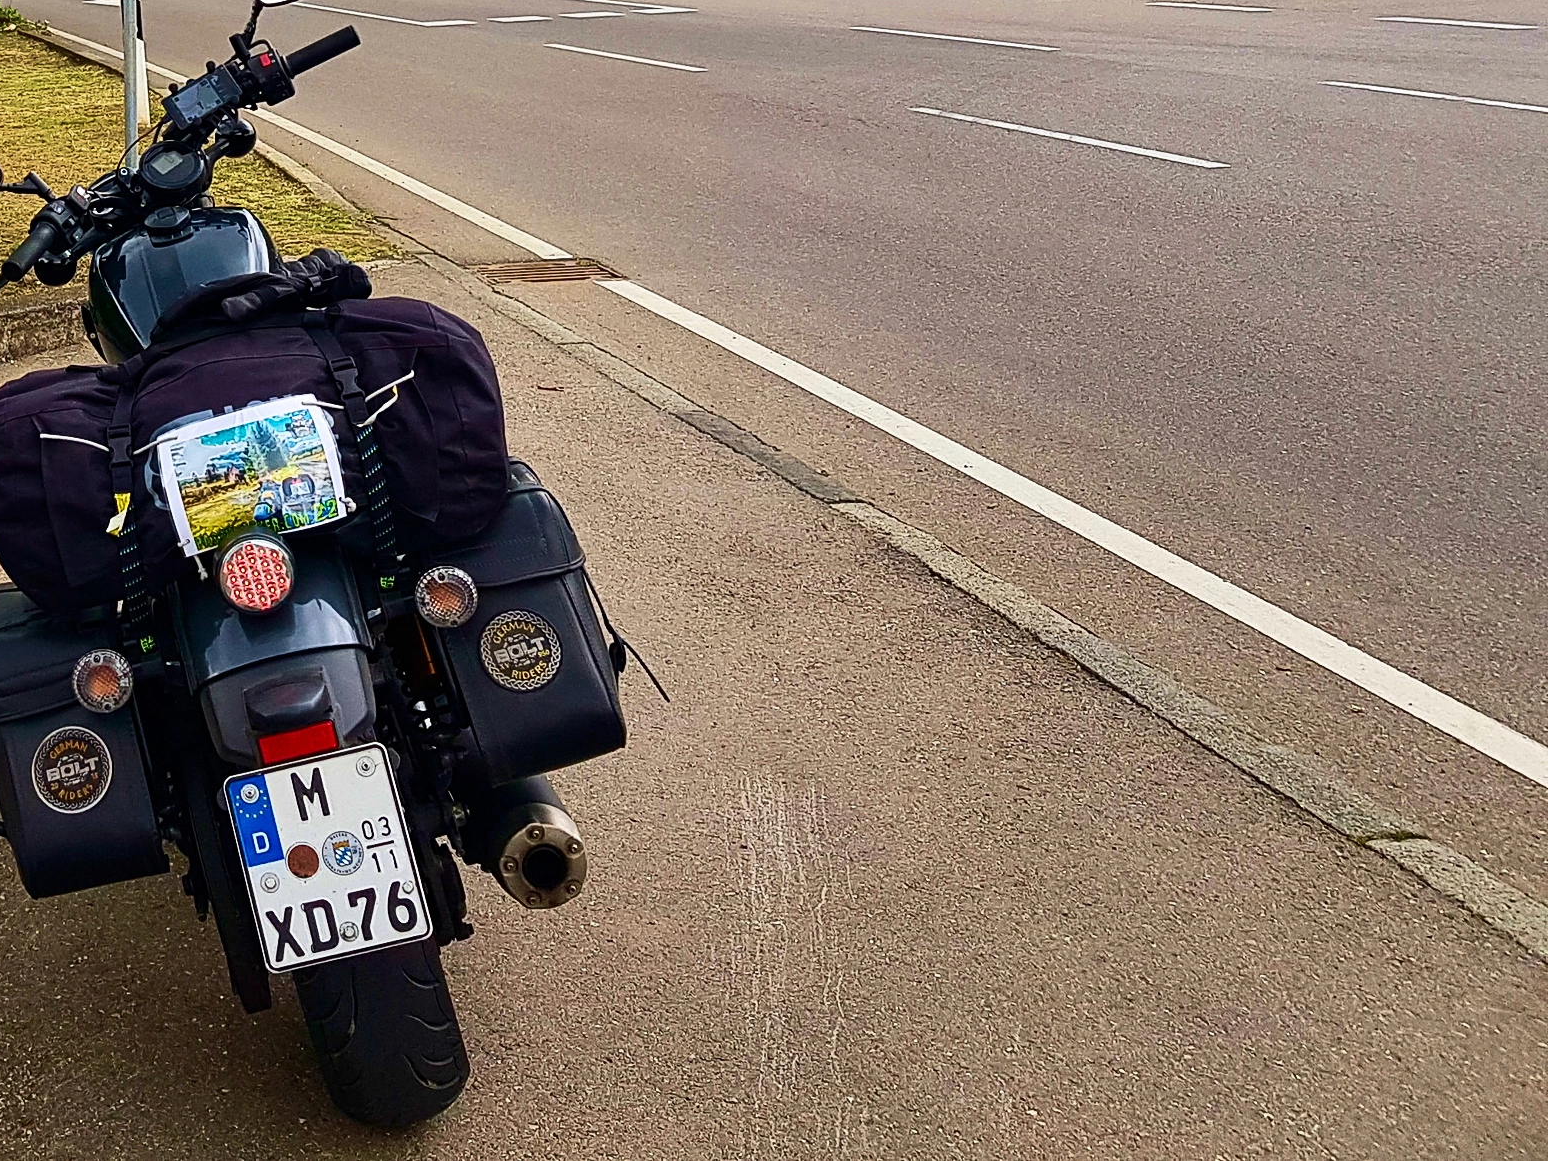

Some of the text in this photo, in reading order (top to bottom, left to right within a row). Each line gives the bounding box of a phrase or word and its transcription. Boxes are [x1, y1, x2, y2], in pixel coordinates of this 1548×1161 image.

[492, 620, 536, 644] GERMAN
[493, 636, 545, 664] BOLT
[511, 660, 548, 680] RIDERS
[49, 739, 89, 759] GERMAN
[45, 756, 99, 782] BOLT
[58, 783, 93, 800] RIDERS
[290, 767, 331, 822] M
[361, 816, 392, 841] 03
[251, 831, 270, 854] D
[371, 849, 399, 873] 11
[265, 880, 418, 963] XD 76
